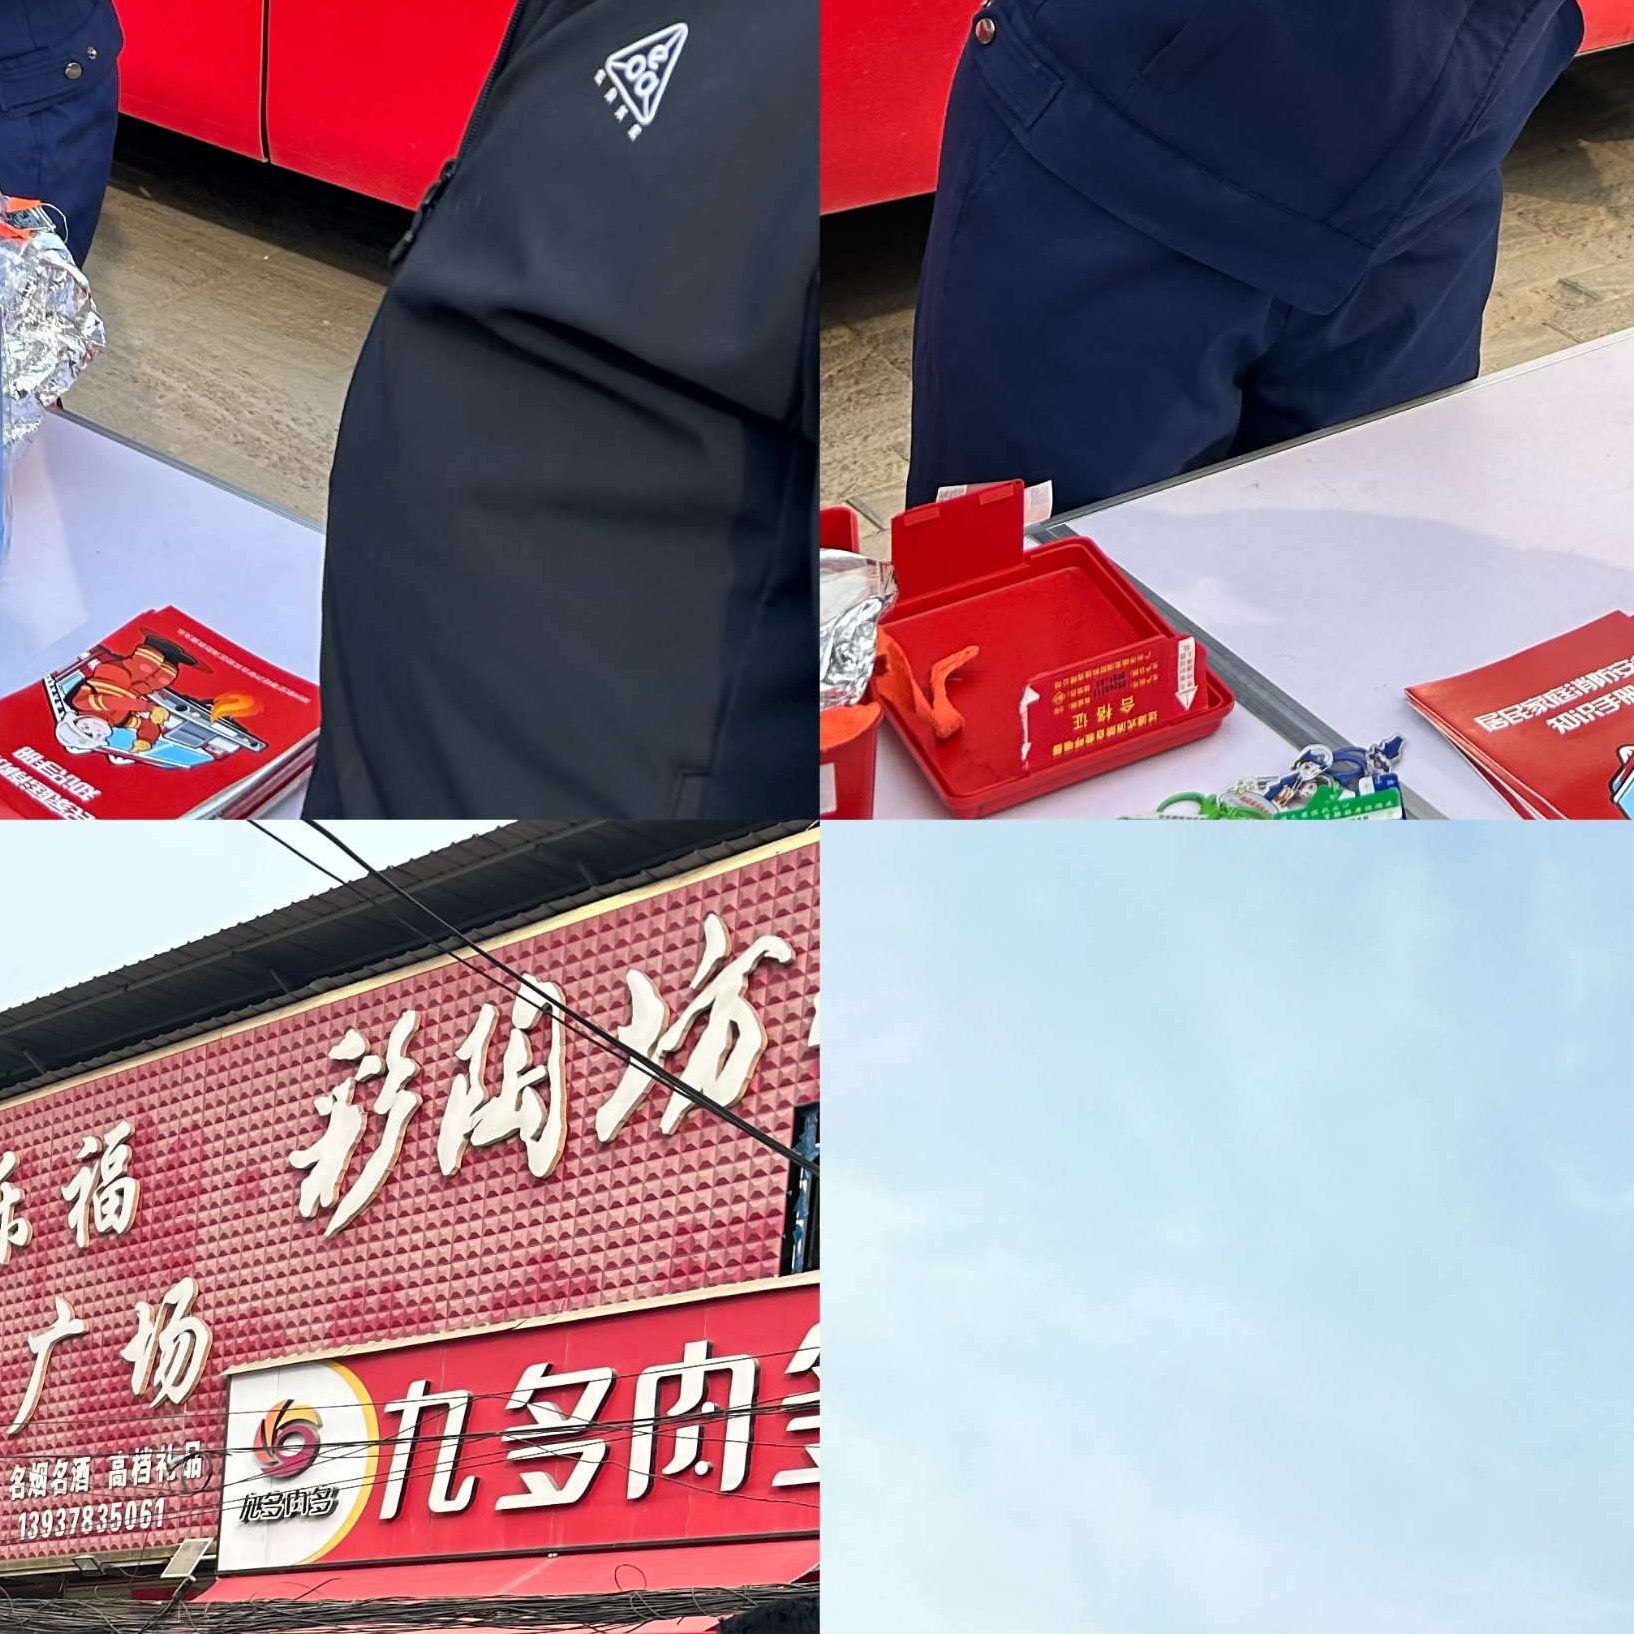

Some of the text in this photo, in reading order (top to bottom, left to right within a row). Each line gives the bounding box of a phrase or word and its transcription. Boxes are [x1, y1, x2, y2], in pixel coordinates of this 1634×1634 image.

[1071, 696, 1136, 730] 合格证
[12, 745, 102, 803] 知识手册
[8, 1456, 92, 1501] 名烟名酒
[107, 1440, 203, 1490] 高档礼品
[17, 1497, 167, 1542] 13937835061
[238, 1486, 340, 1525] 九多肉多
